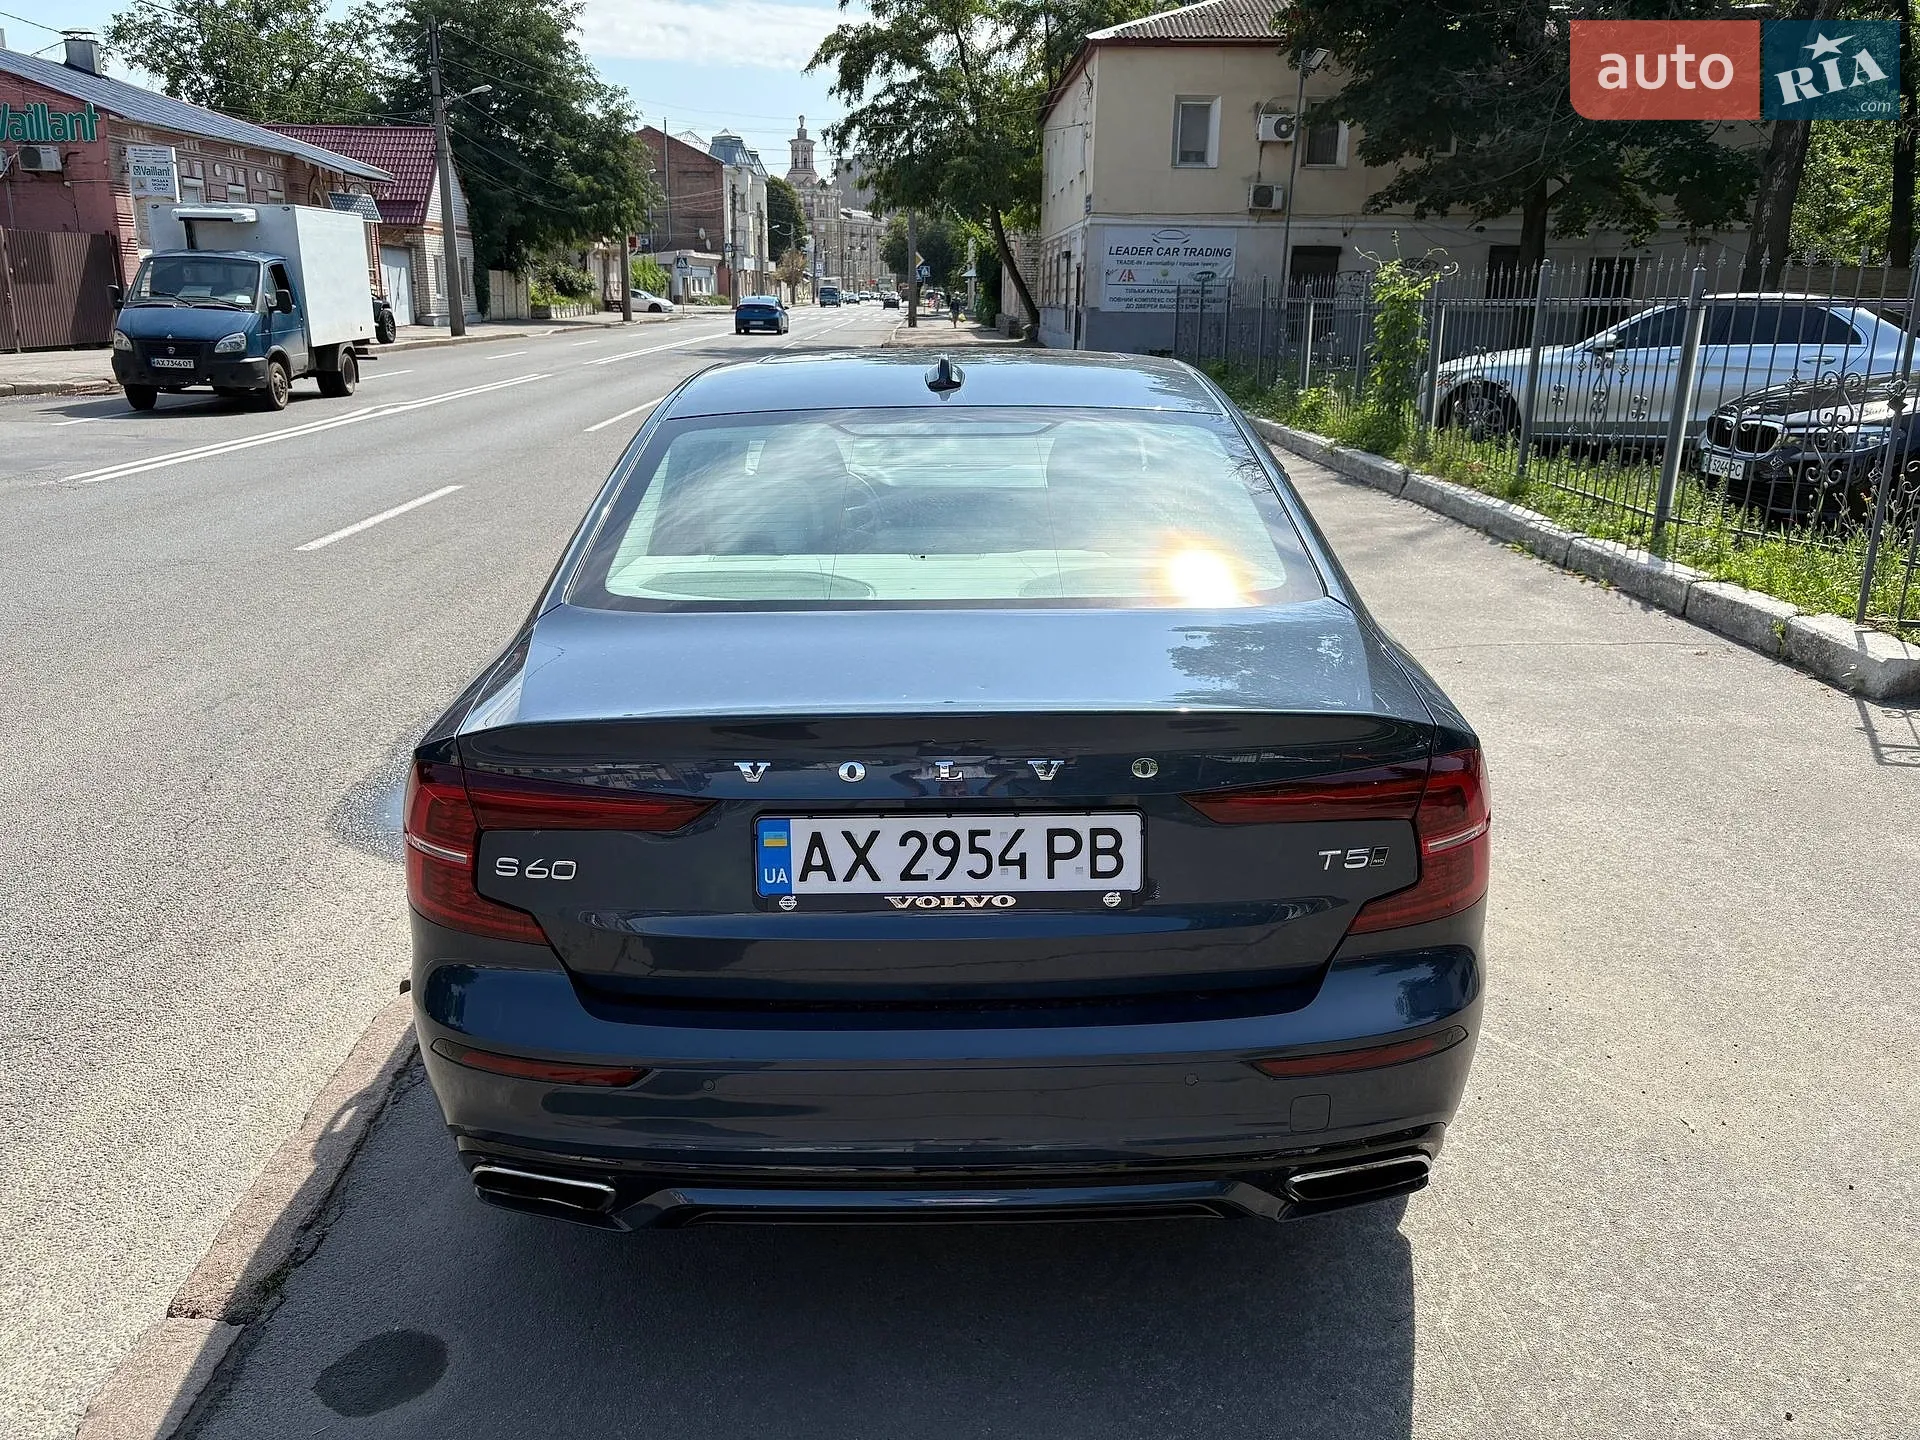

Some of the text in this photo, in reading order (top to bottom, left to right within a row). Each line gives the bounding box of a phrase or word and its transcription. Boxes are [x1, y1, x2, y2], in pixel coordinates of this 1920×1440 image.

[141, 165, 170, 177] Vaillant
[1108, 246, 1232, 257] LEADER CAR TRADING
[734, 757, 1159, 782] VOLVO
[798, 827, 1125, 883] AX 2954 PB
[1318, 847, 1370, 870] T5
[496, 857, 577, 880] S60
[764, 868, 788, 884] UA
[884, 894, 1016, 909] VOLVO
